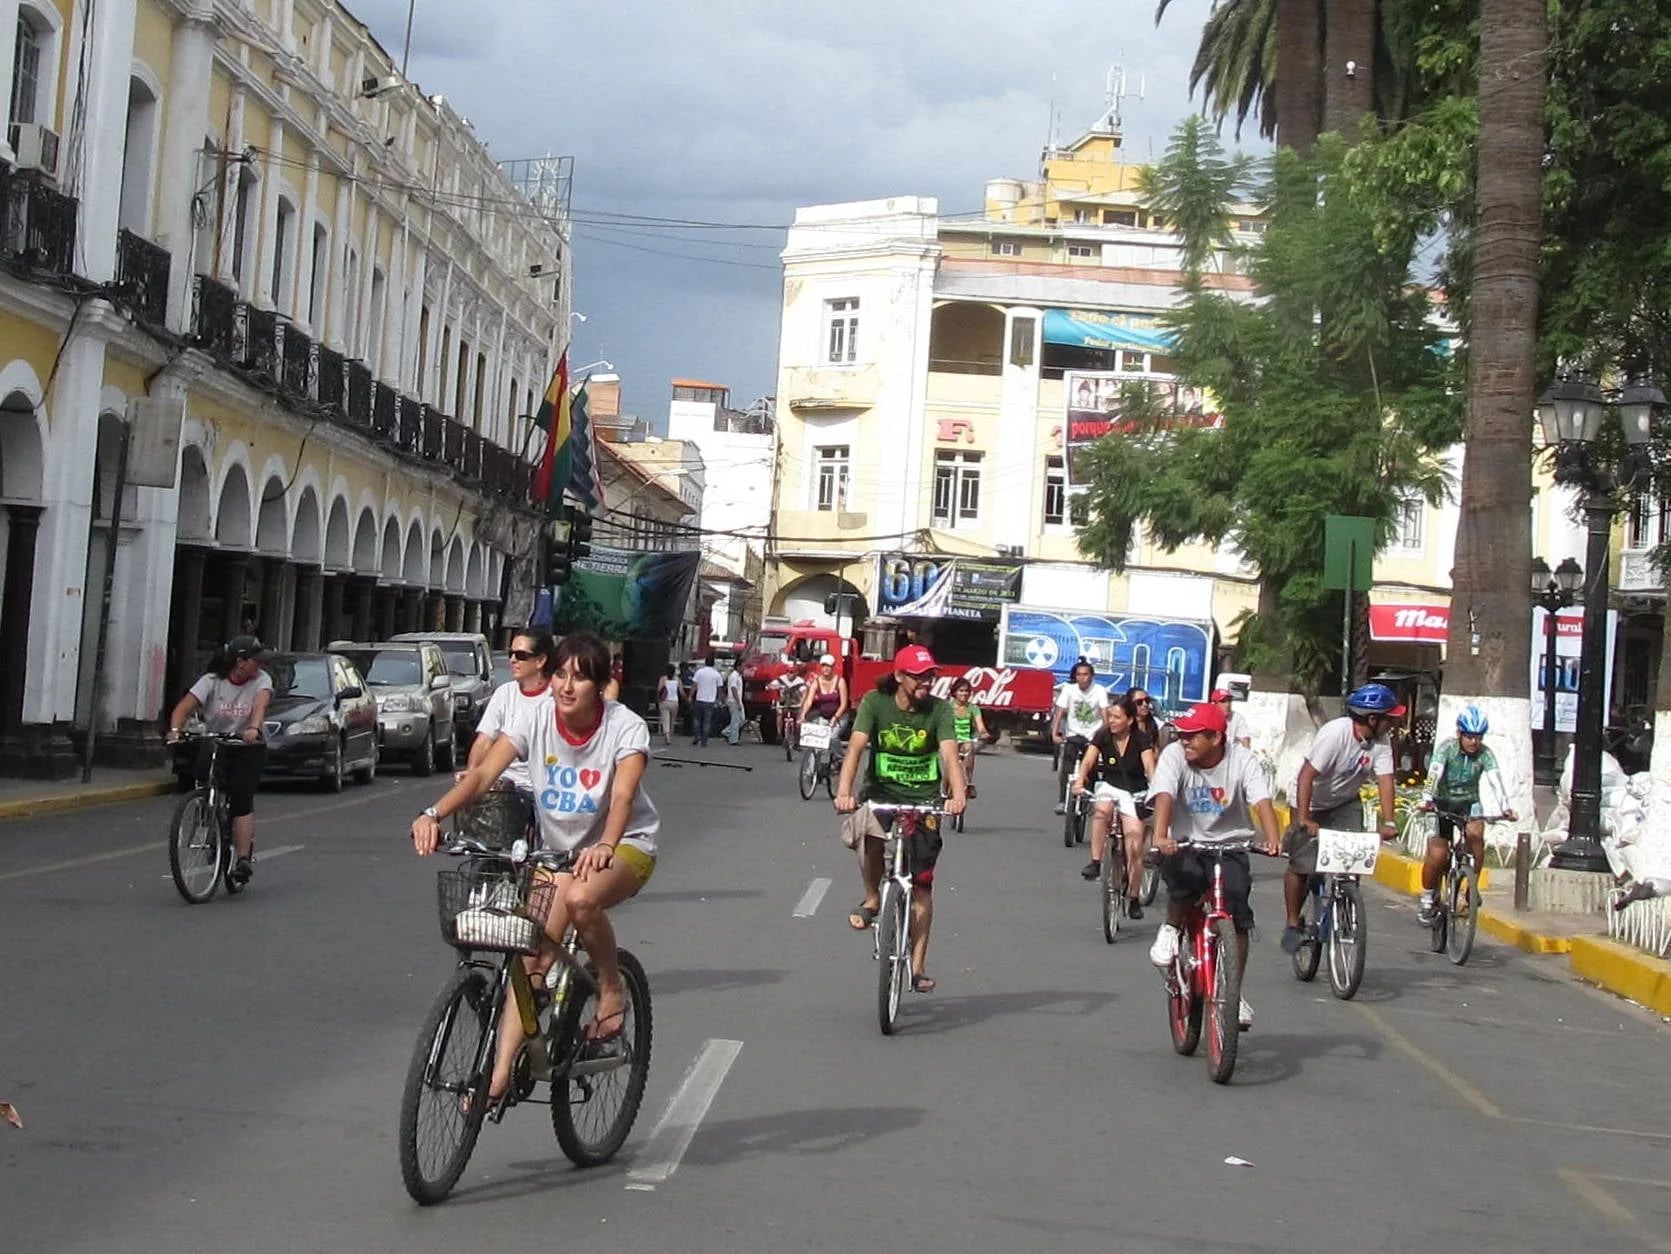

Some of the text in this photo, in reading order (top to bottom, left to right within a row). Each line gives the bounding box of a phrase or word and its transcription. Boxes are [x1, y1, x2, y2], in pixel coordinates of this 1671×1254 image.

[943, 606, 982, 619] PLANETA
[1393, 608, 1448, 629] Ma
[1556, 621, 1583, 633] ural
[546, 764, 578, 789] YO
[540, 790, 598, 814] CBA
